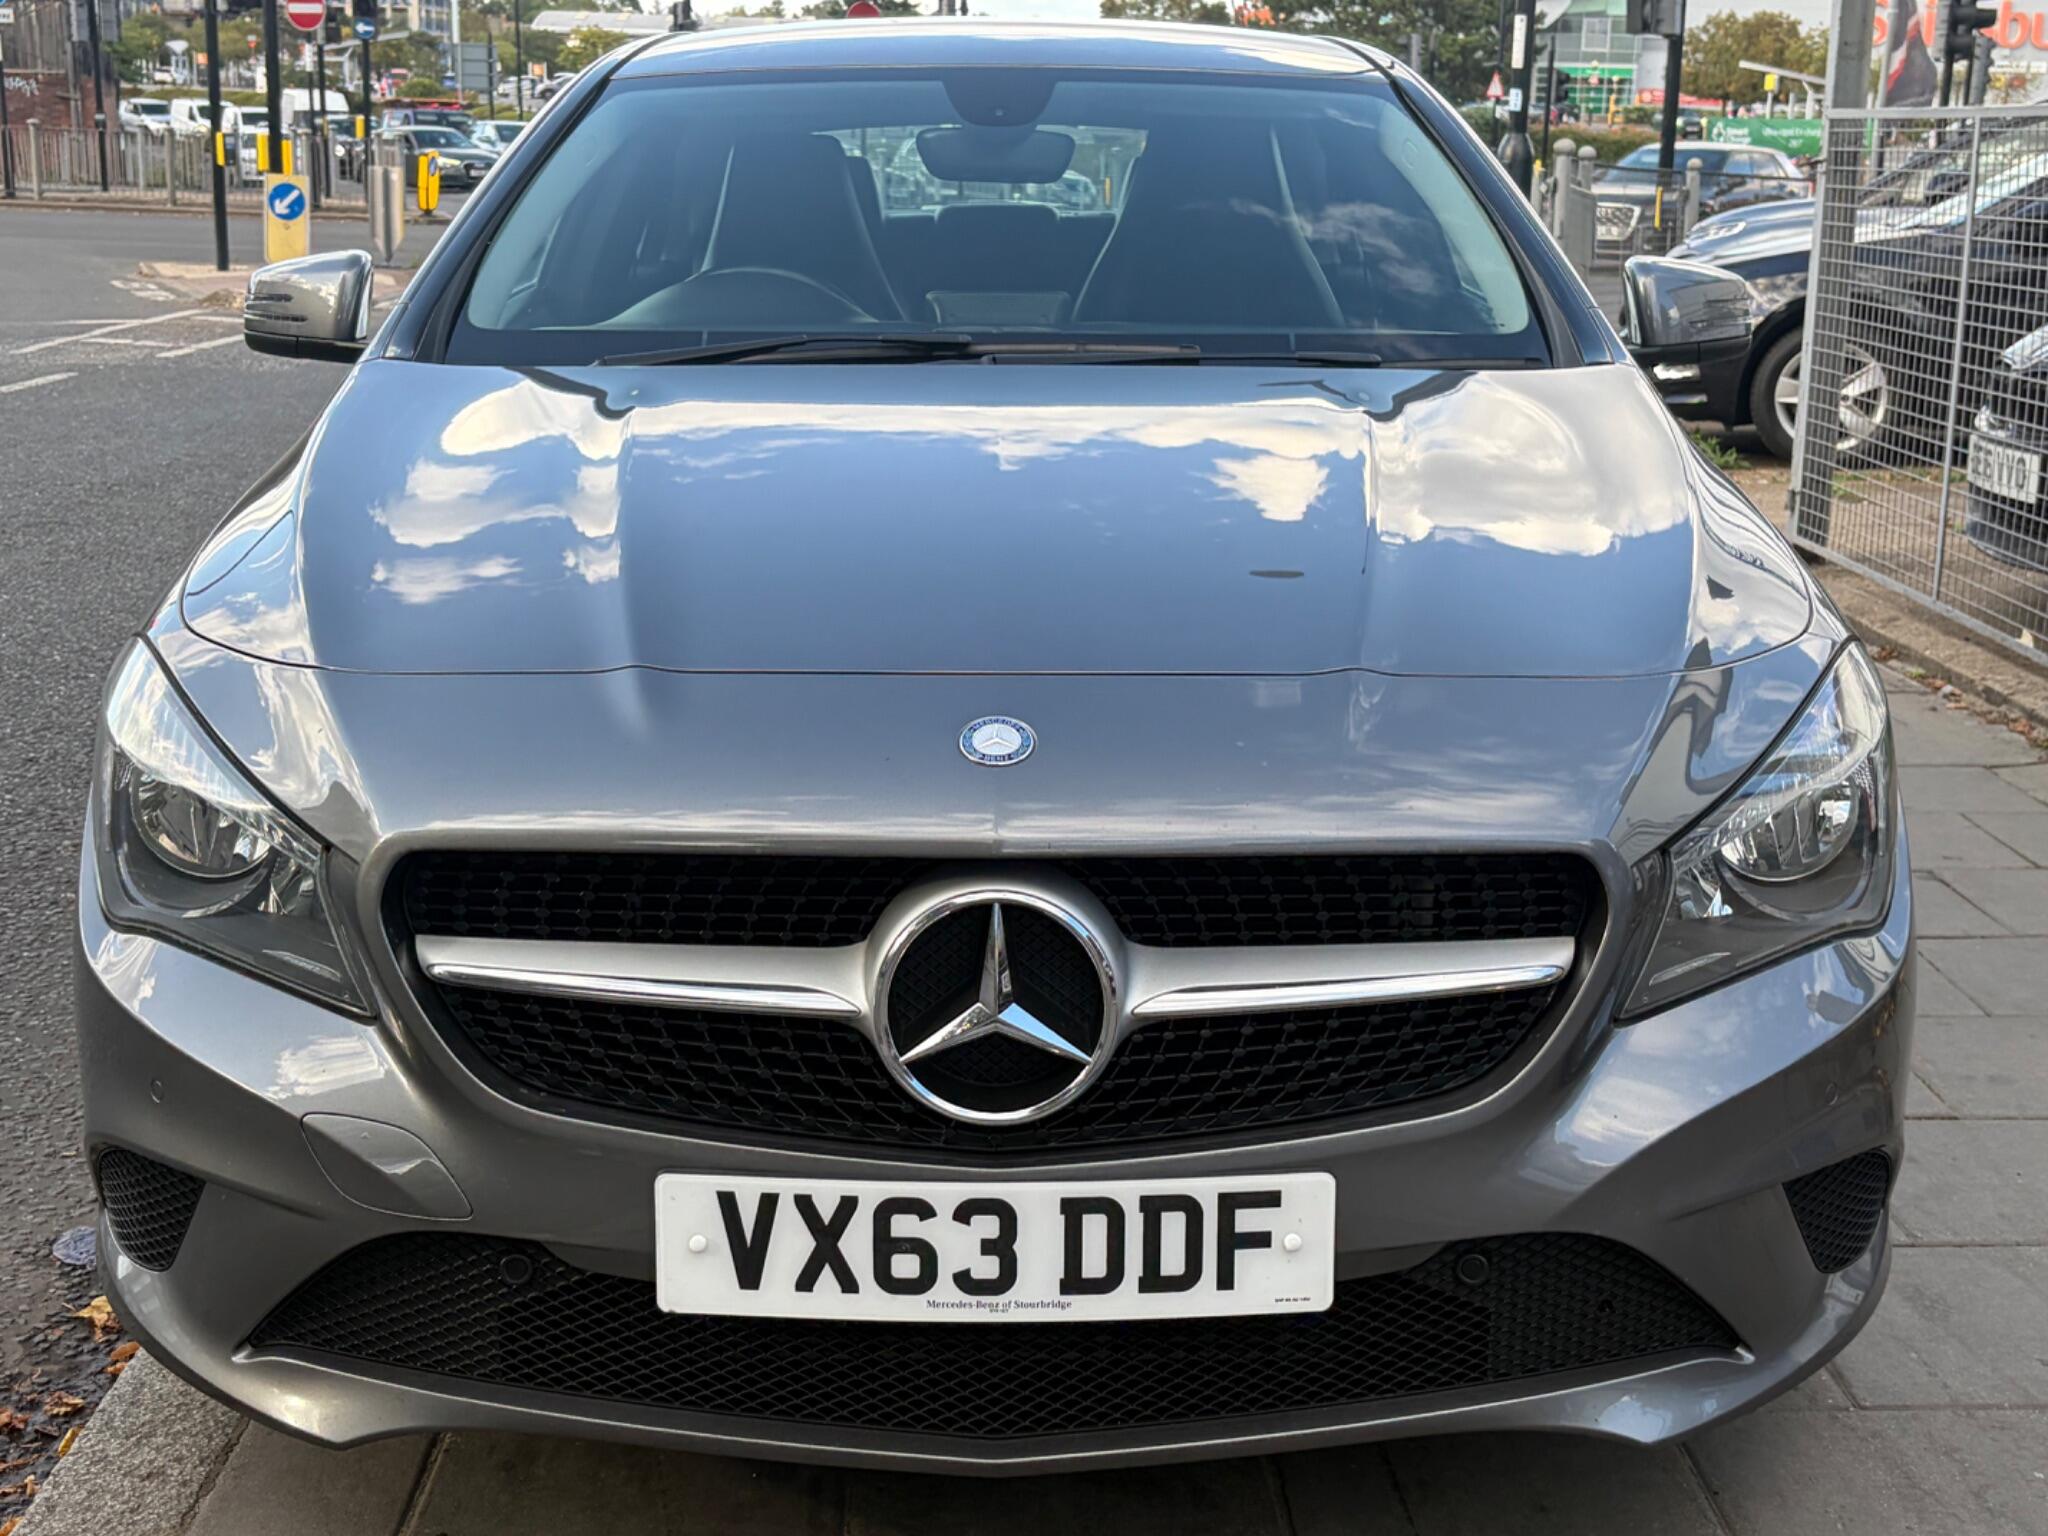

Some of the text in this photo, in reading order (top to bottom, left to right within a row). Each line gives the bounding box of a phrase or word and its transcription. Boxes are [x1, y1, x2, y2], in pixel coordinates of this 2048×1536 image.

[716, 1190, 1282, 1296] VX63 DDF
[926, 1299, 1073, 1311] Mercedes-Benz of Stourbridge
